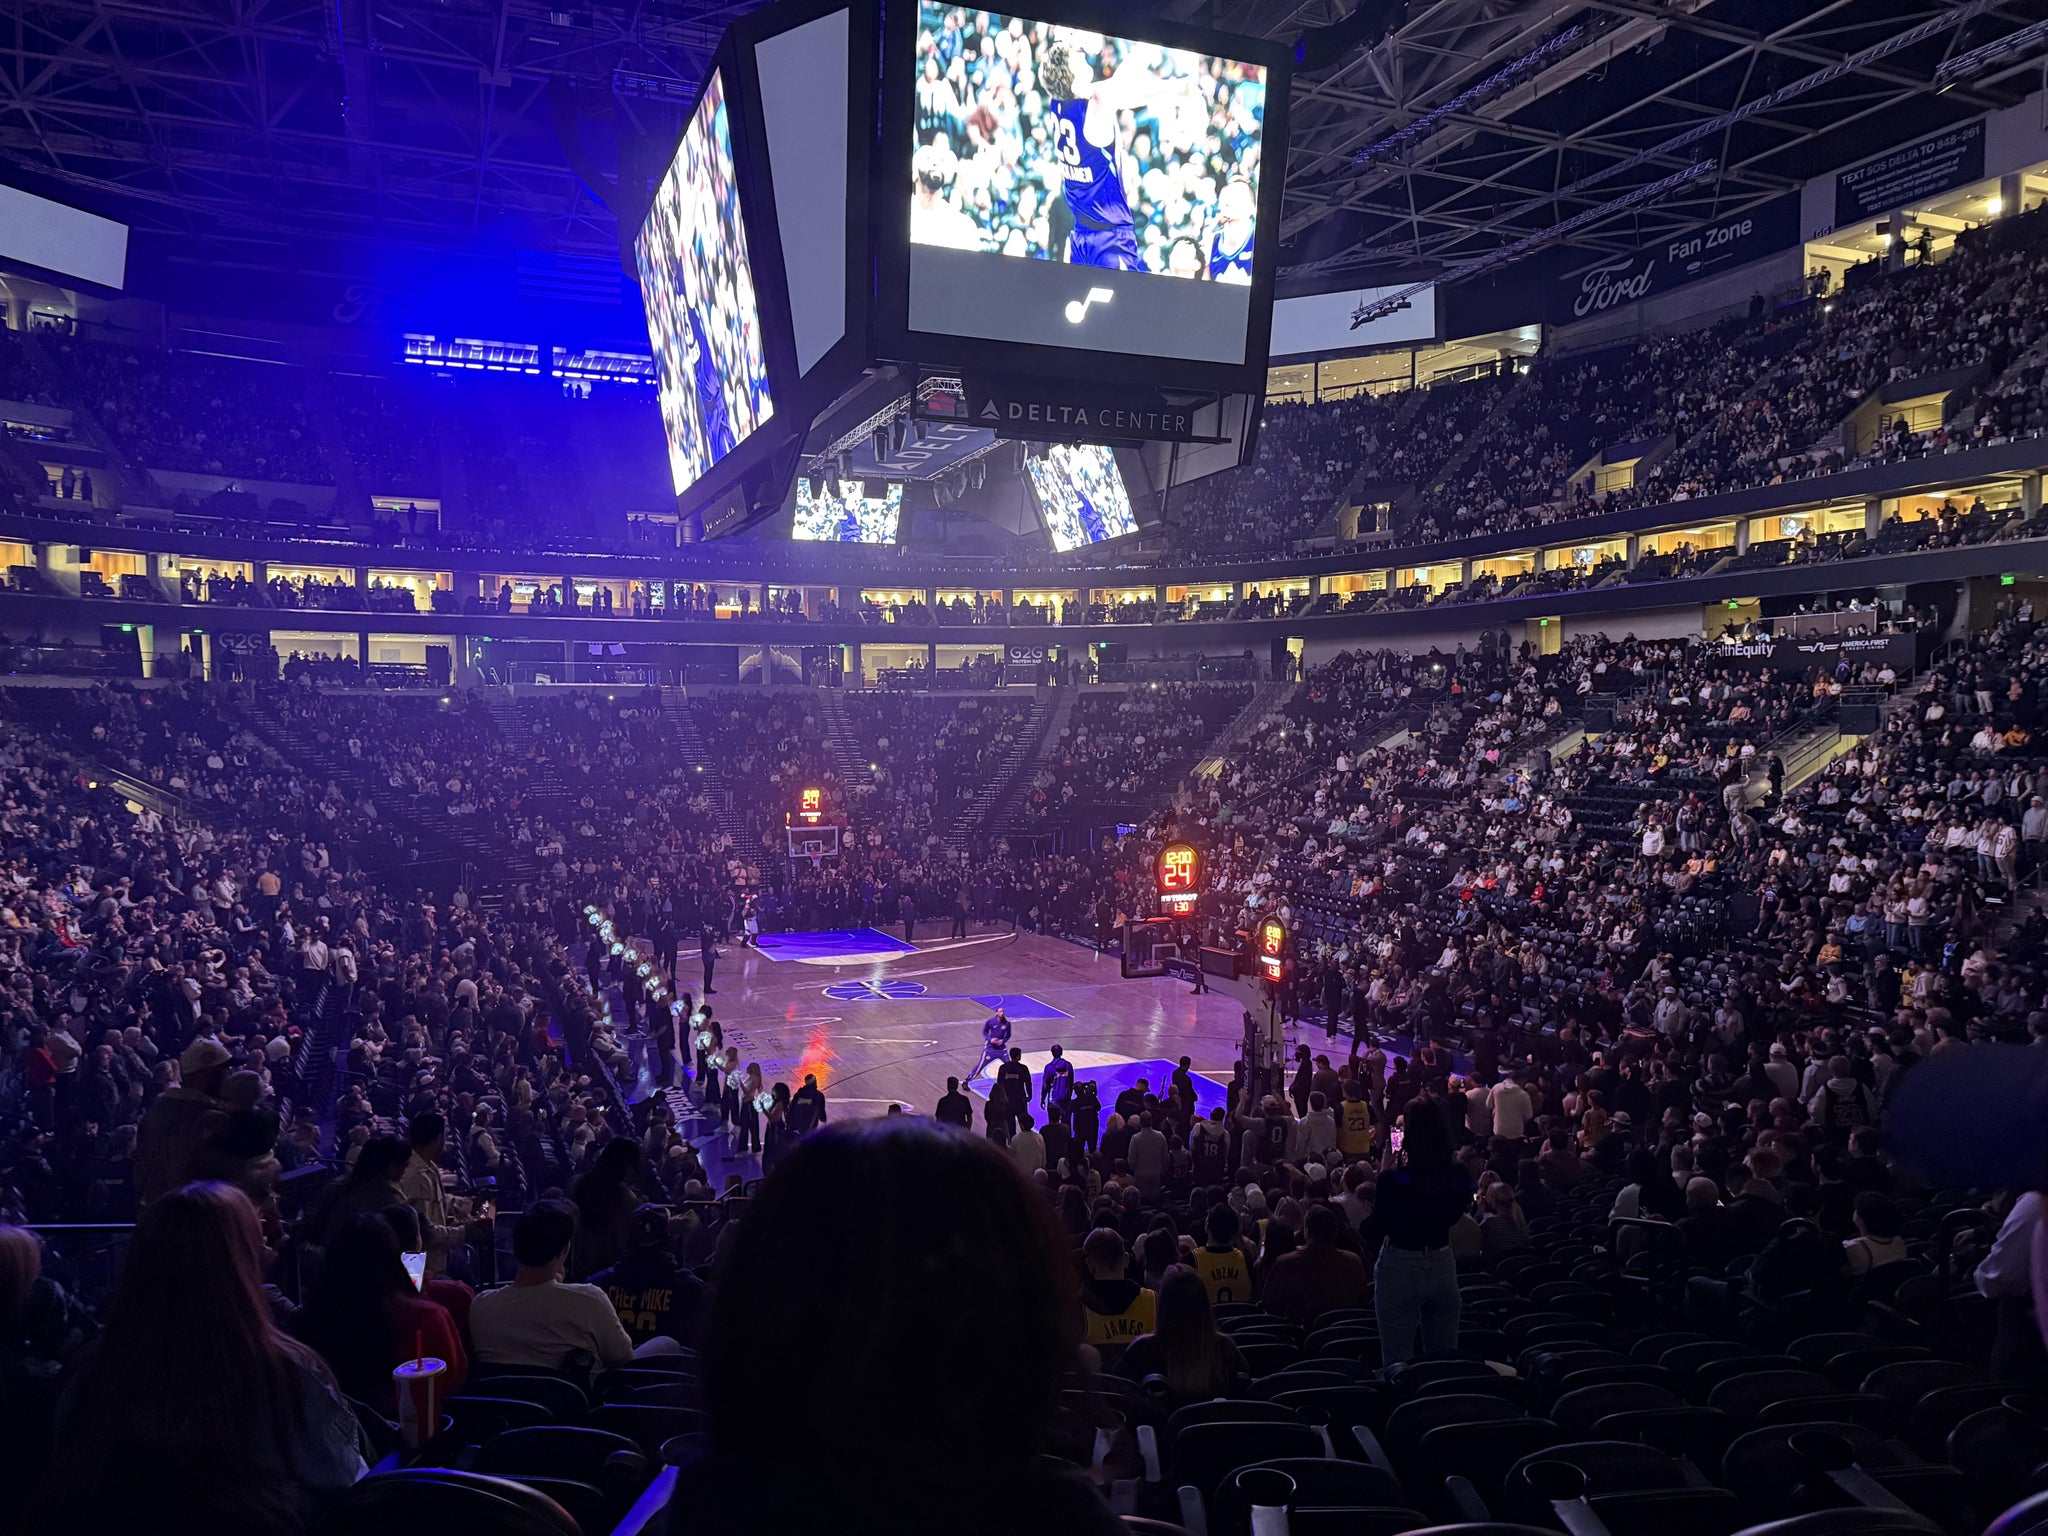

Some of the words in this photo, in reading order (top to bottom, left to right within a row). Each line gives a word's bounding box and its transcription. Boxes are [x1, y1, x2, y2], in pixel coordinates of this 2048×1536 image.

[1841, 168, 1865, 187] TEXT
[1866, 160, 1888, 177] SOS
[1888, 148, 1919, 168] DELTA
[1920, 143, 1935, 156] TO
[1668, 238, 1701, 262] Fan
[1706, 218, 1752, 248] Zone
[1573, 257, 1655, 317] Ford
[1008, 402, 1089, 426] DELTA
[1099, 408, 1186, 433] CENTER
[895, 424, 979, 459] DELT
[1010, 646, 1043, 659] G2G
[1706, 642, 1775, 658] ealthEquity
[1166, 851, 1192, 865] 12:00
[1164, 864, 1190, 886] 24
[1266, 936, 1278, 952] 24
[1272, 1126, 1283, 1144] 0
[1348, 1117, 1365, 1131] 23
[640, 1287, 673, 1312] MIKE
[1104, 1318, 1144, 1340] JAMES
